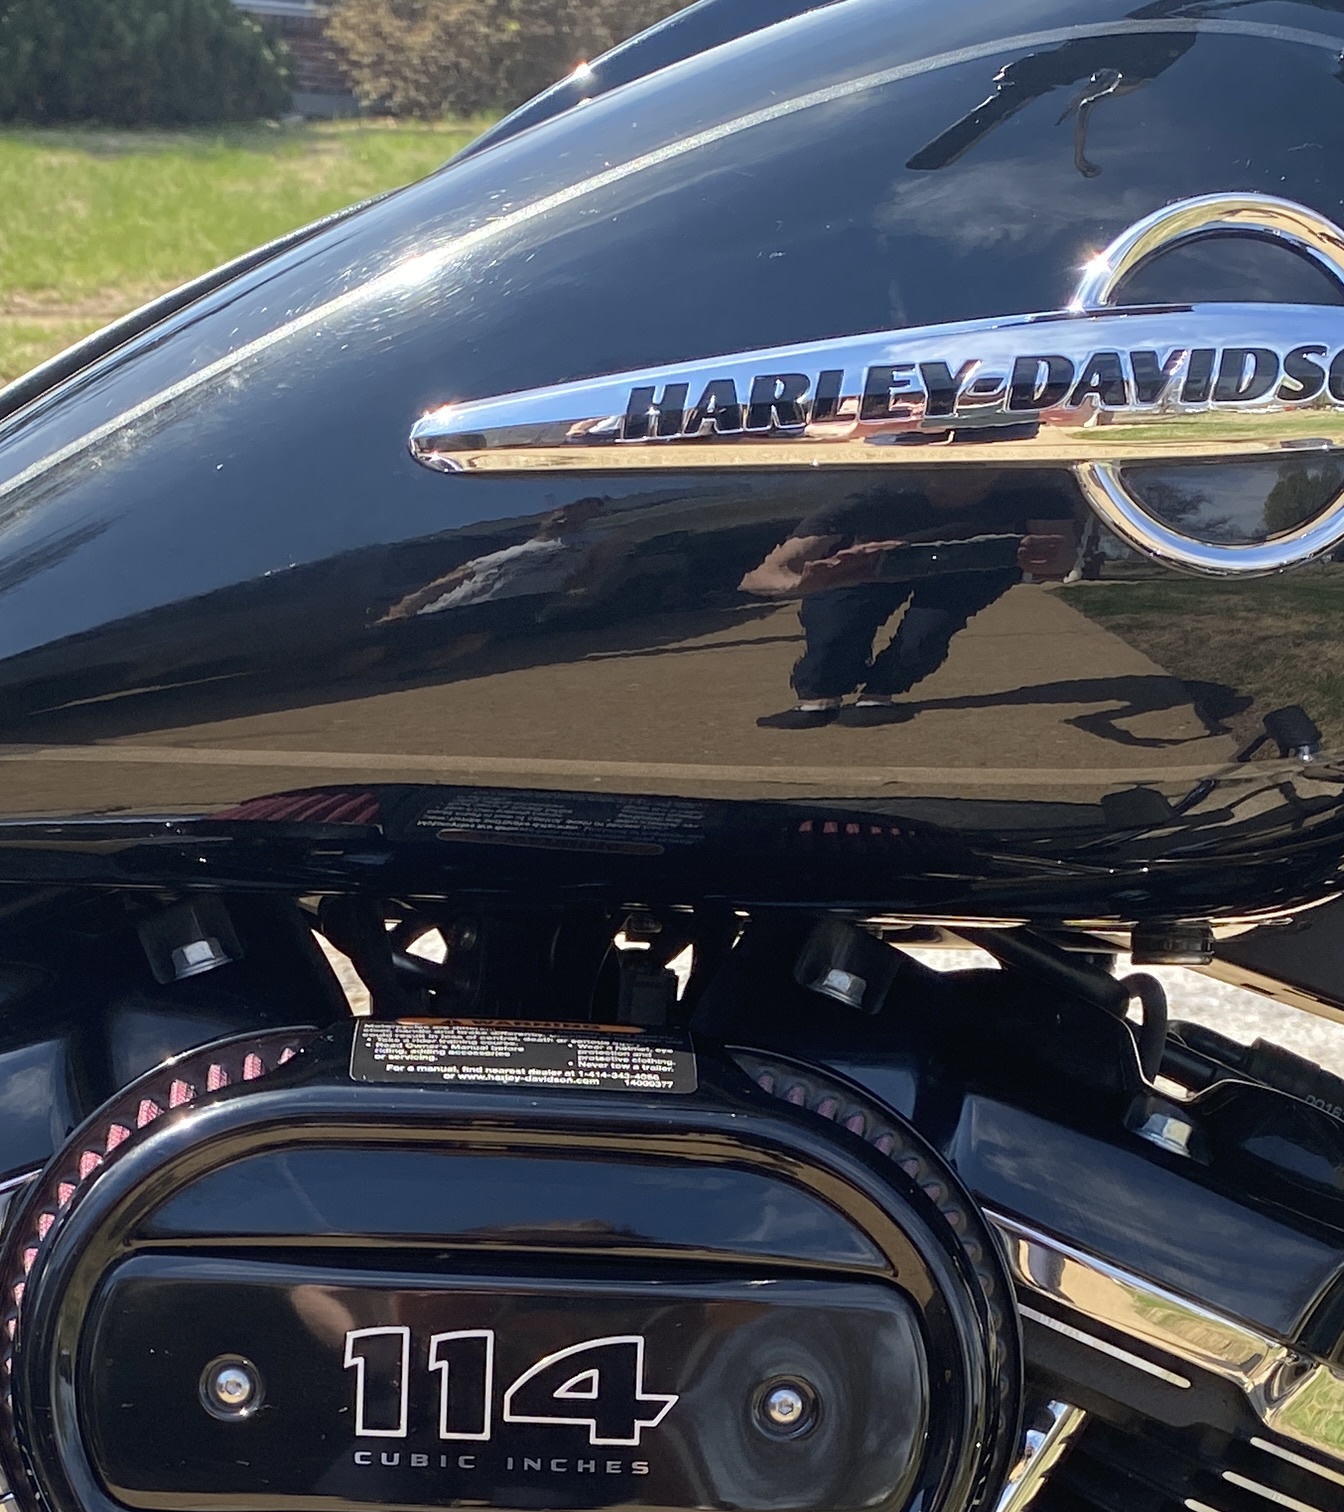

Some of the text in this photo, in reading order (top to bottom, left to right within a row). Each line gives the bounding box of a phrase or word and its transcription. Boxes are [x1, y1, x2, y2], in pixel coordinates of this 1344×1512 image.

[388, 1054, 438, 1062] servicing.
[386, 1064, 405, 1072] For
[417, 1065, 460, 1073] manual,
[485, 1067, 526, 1075] nearest
[528, 1068, 563, 1076] dealer
[343, 1325, 679, 1446] 114
[353, 1450, 650, 1475] CUBIC INCHES
